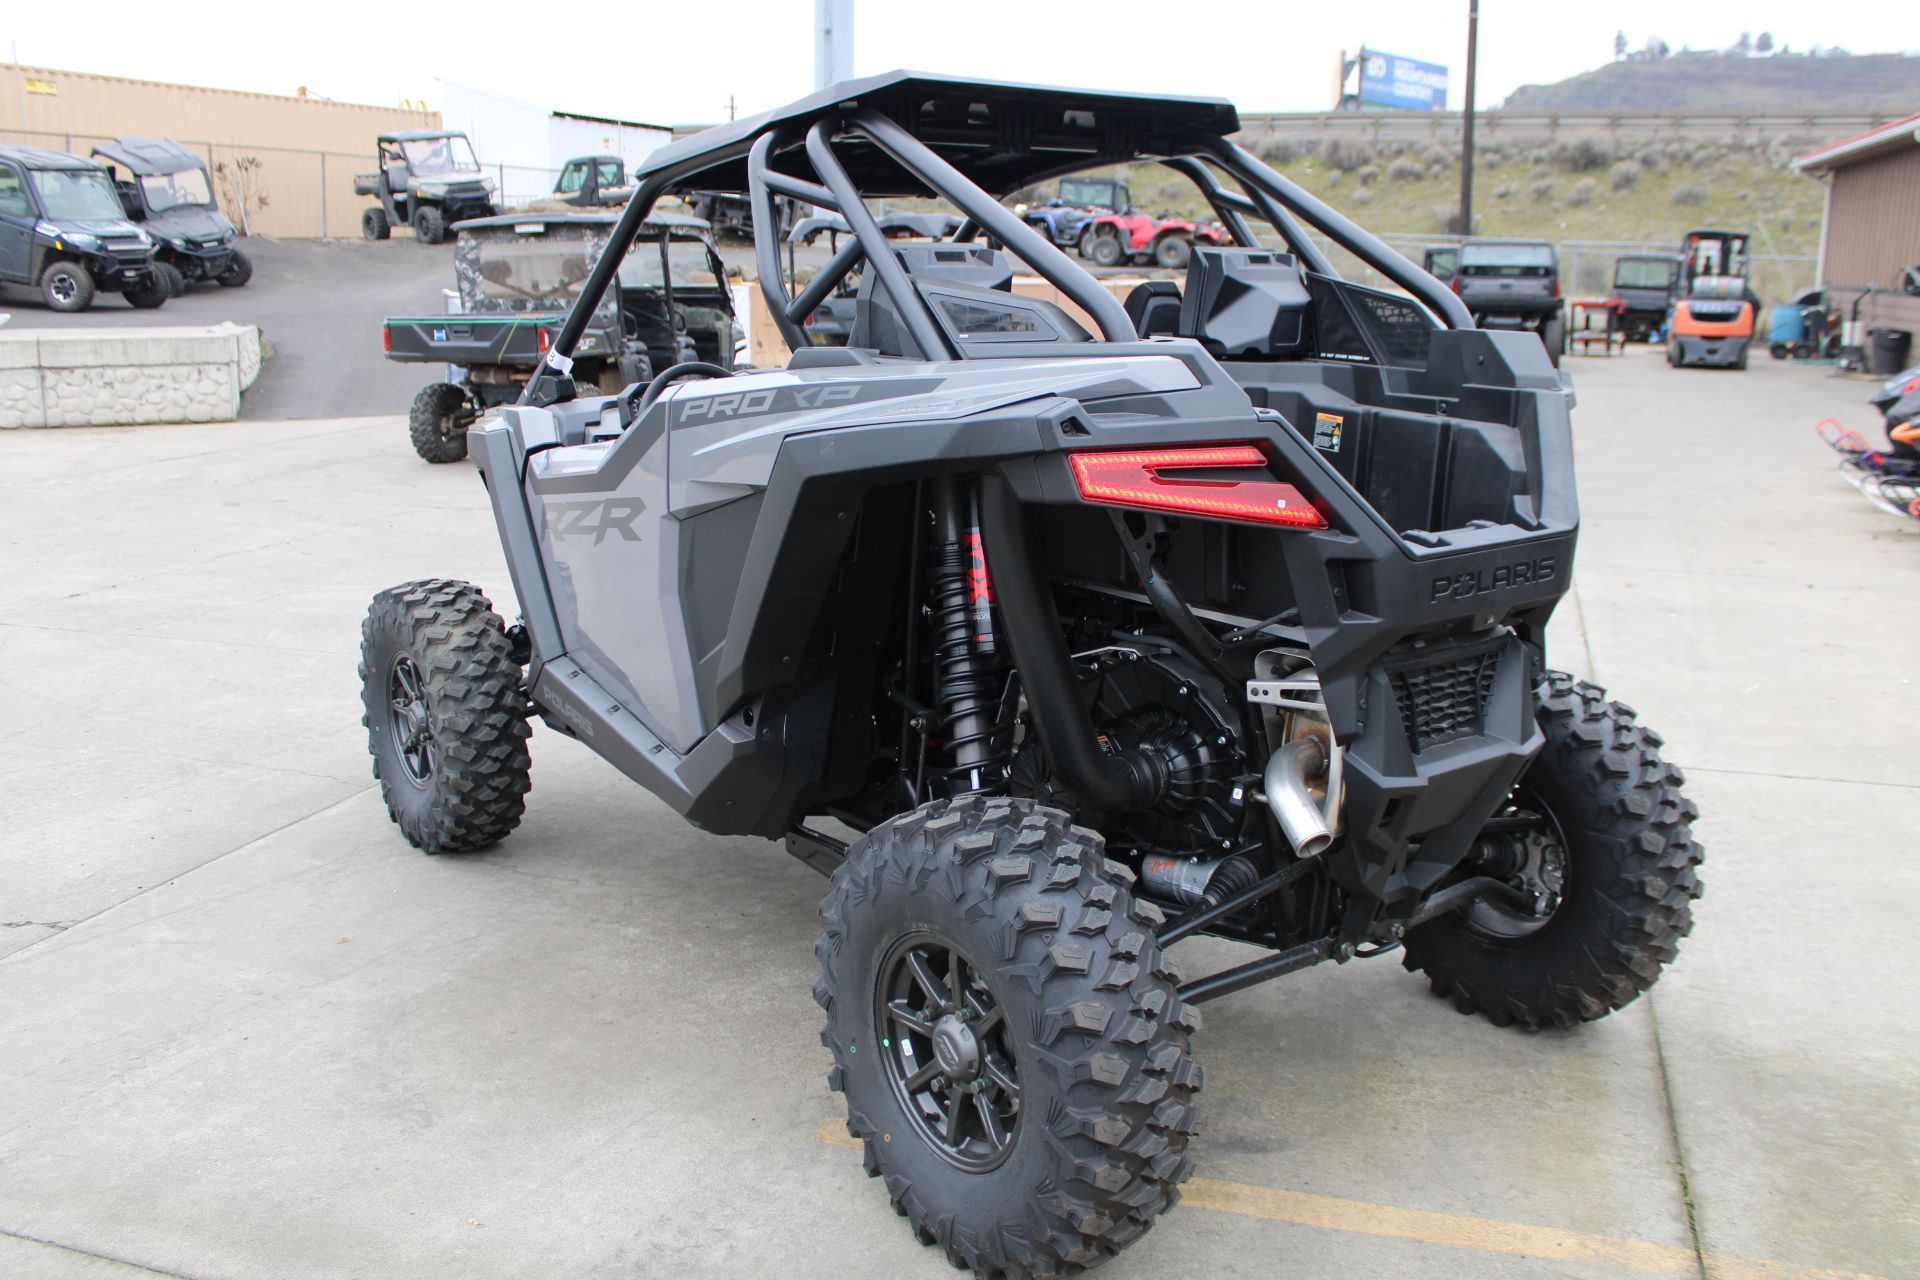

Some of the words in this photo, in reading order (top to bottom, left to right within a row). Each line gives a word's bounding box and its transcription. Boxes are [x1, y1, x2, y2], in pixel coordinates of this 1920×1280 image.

[679, 389, 778, 423] PRO
[783, 384, 863, 407] XP
[1430, 555, 1556, 604] POLARIS
[543, 685, 594, 737] POLARIS
